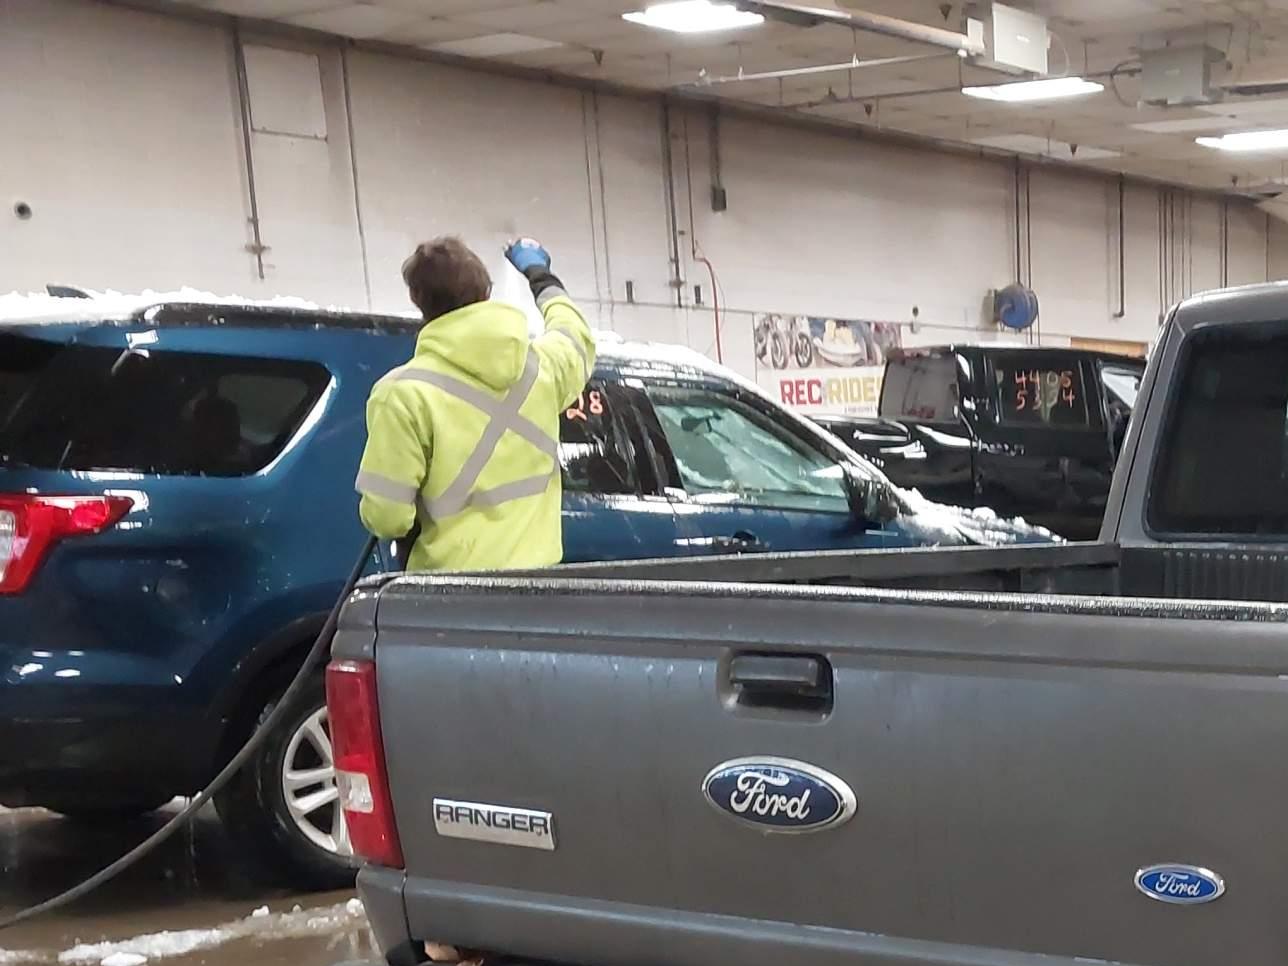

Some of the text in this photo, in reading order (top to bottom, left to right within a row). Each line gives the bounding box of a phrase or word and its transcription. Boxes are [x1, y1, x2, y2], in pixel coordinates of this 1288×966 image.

[780, 376, 881, 404] REC RIDE
[730, 771, 811, 820] Ford
[435, 804, 548, 834] RANGER
[1155, 872, 1201, 896] Ford
